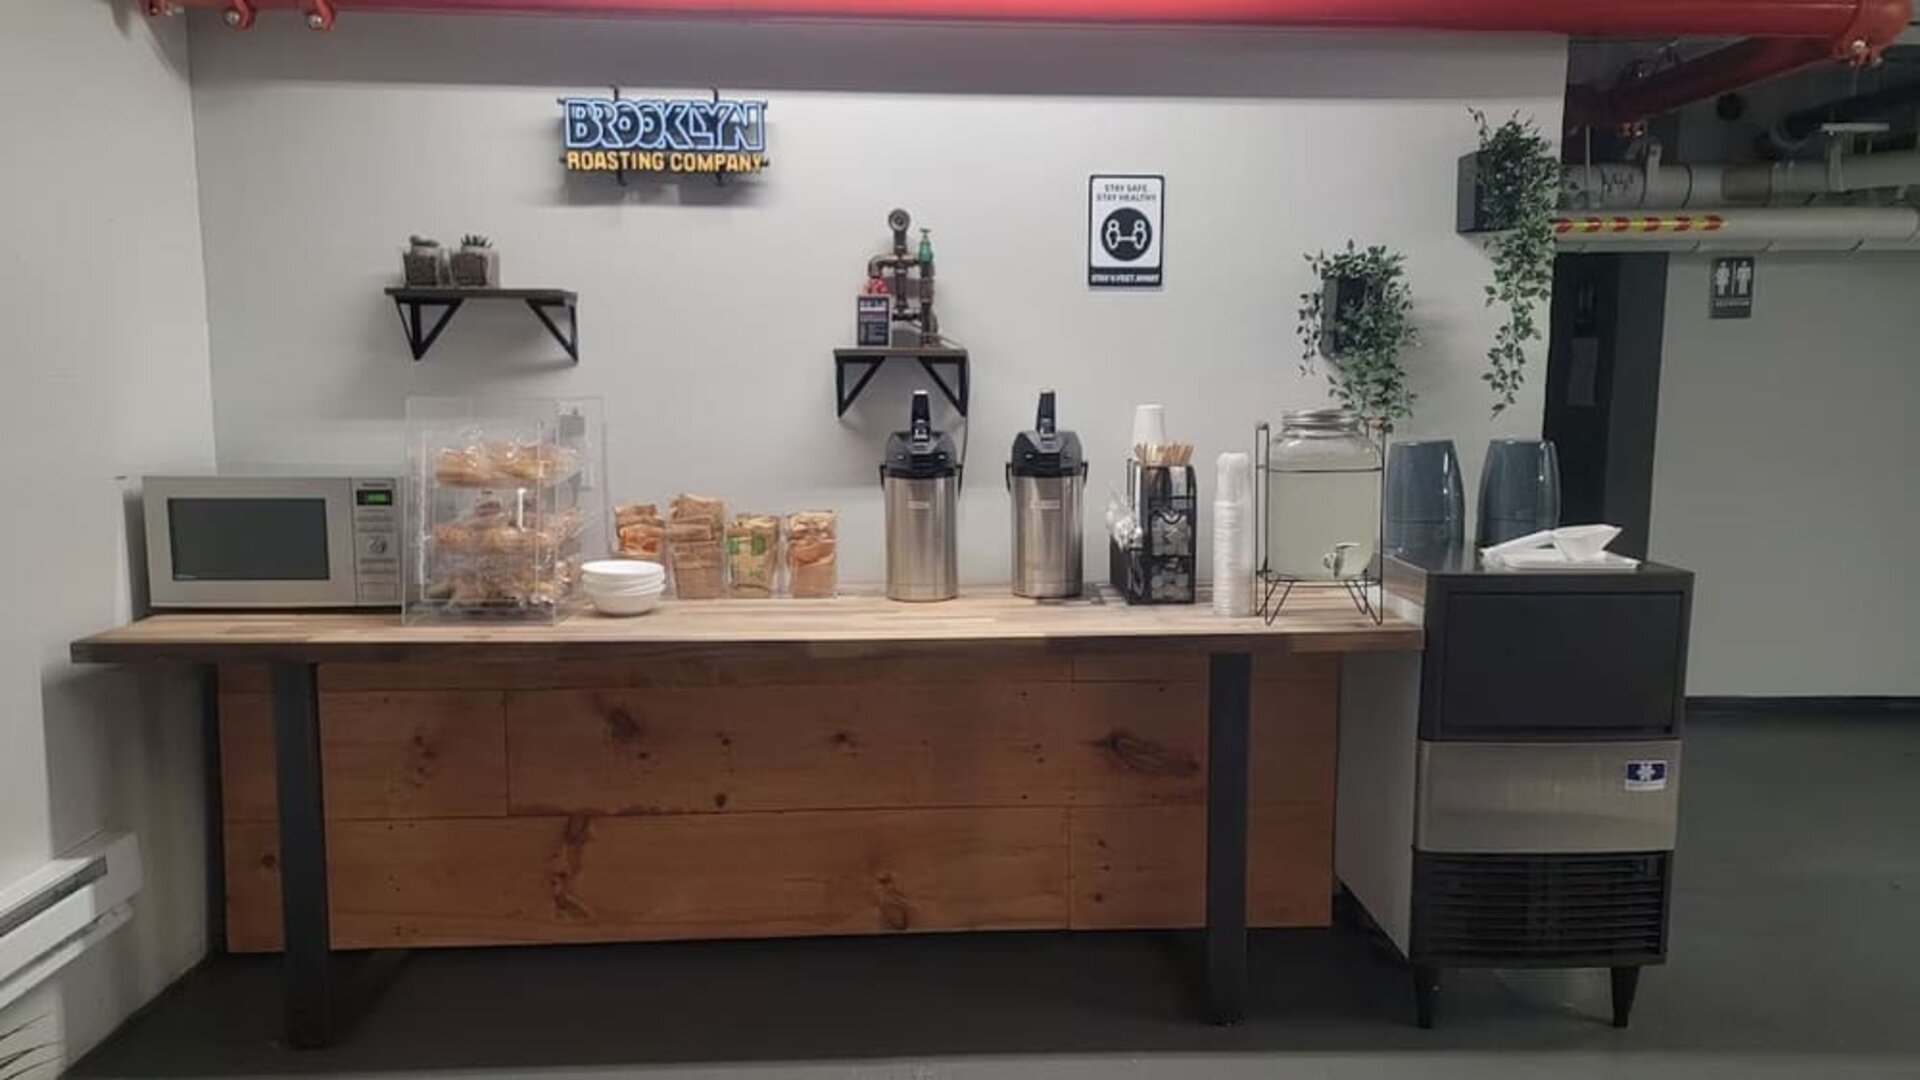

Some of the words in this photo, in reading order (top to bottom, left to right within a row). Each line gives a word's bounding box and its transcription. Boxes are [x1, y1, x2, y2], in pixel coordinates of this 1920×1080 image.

[565, 99, 765, 150] BROOKLYN
[566, 152, 665, 171] ROASTING
[669, 153, 764, 173] COMPANY
[1104, 184, 1125, 192] STAY
[1096, 193, 1118, 201] STAY
